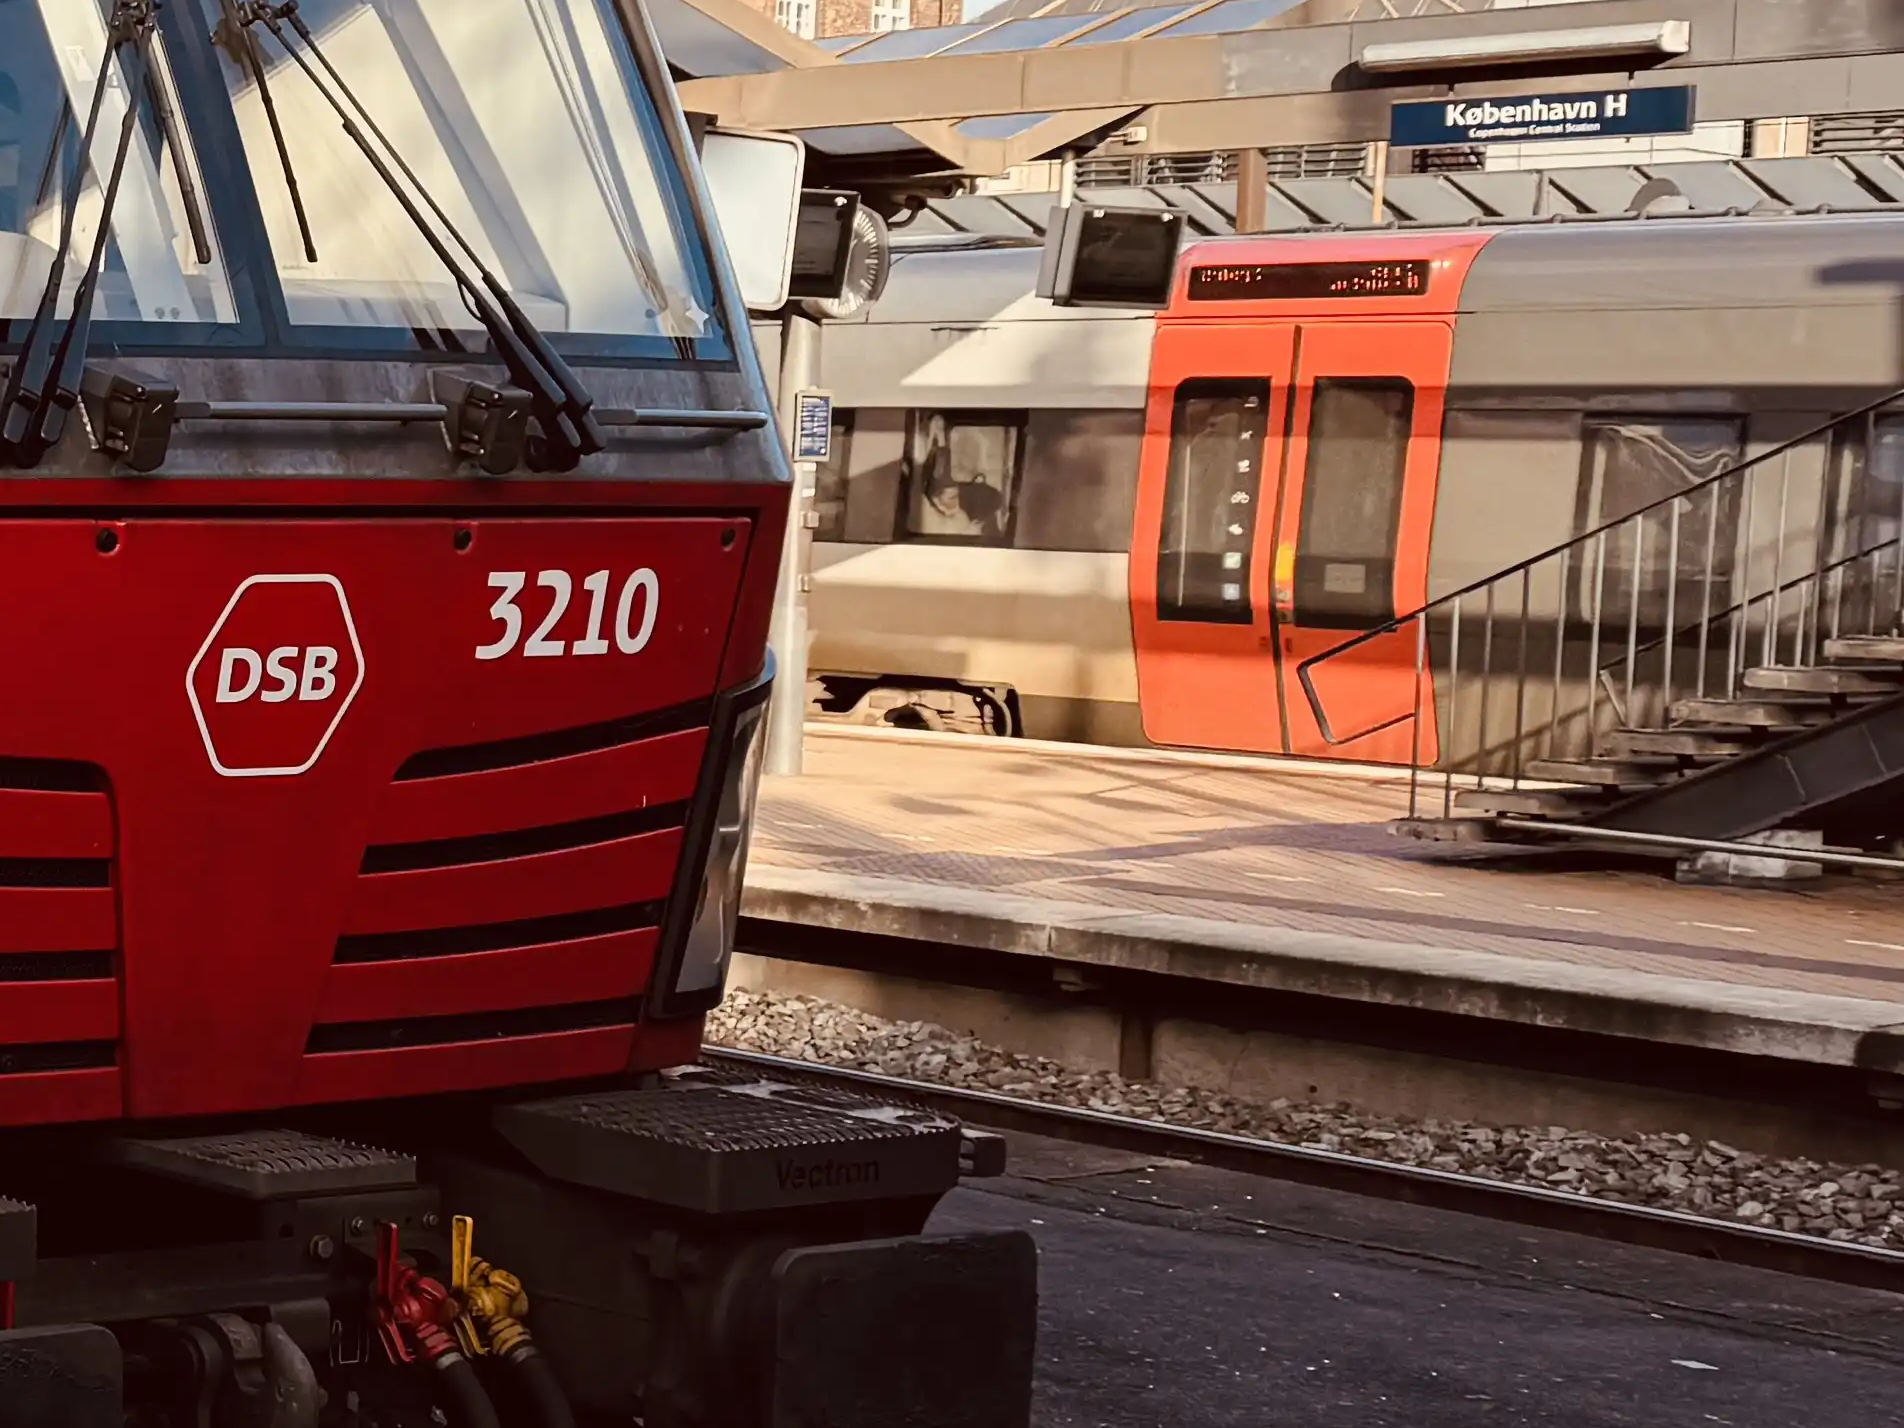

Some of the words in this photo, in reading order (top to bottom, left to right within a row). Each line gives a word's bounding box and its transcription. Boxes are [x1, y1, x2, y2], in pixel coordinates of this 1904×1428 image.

[1445, 98, 1597, 126] København
[1604, 93, 1628, 117] H
[475, 567, 660, 659] 3210
[216, 646, 339, 703] DSB
[775, 1158, 880, 1191] Vectron
